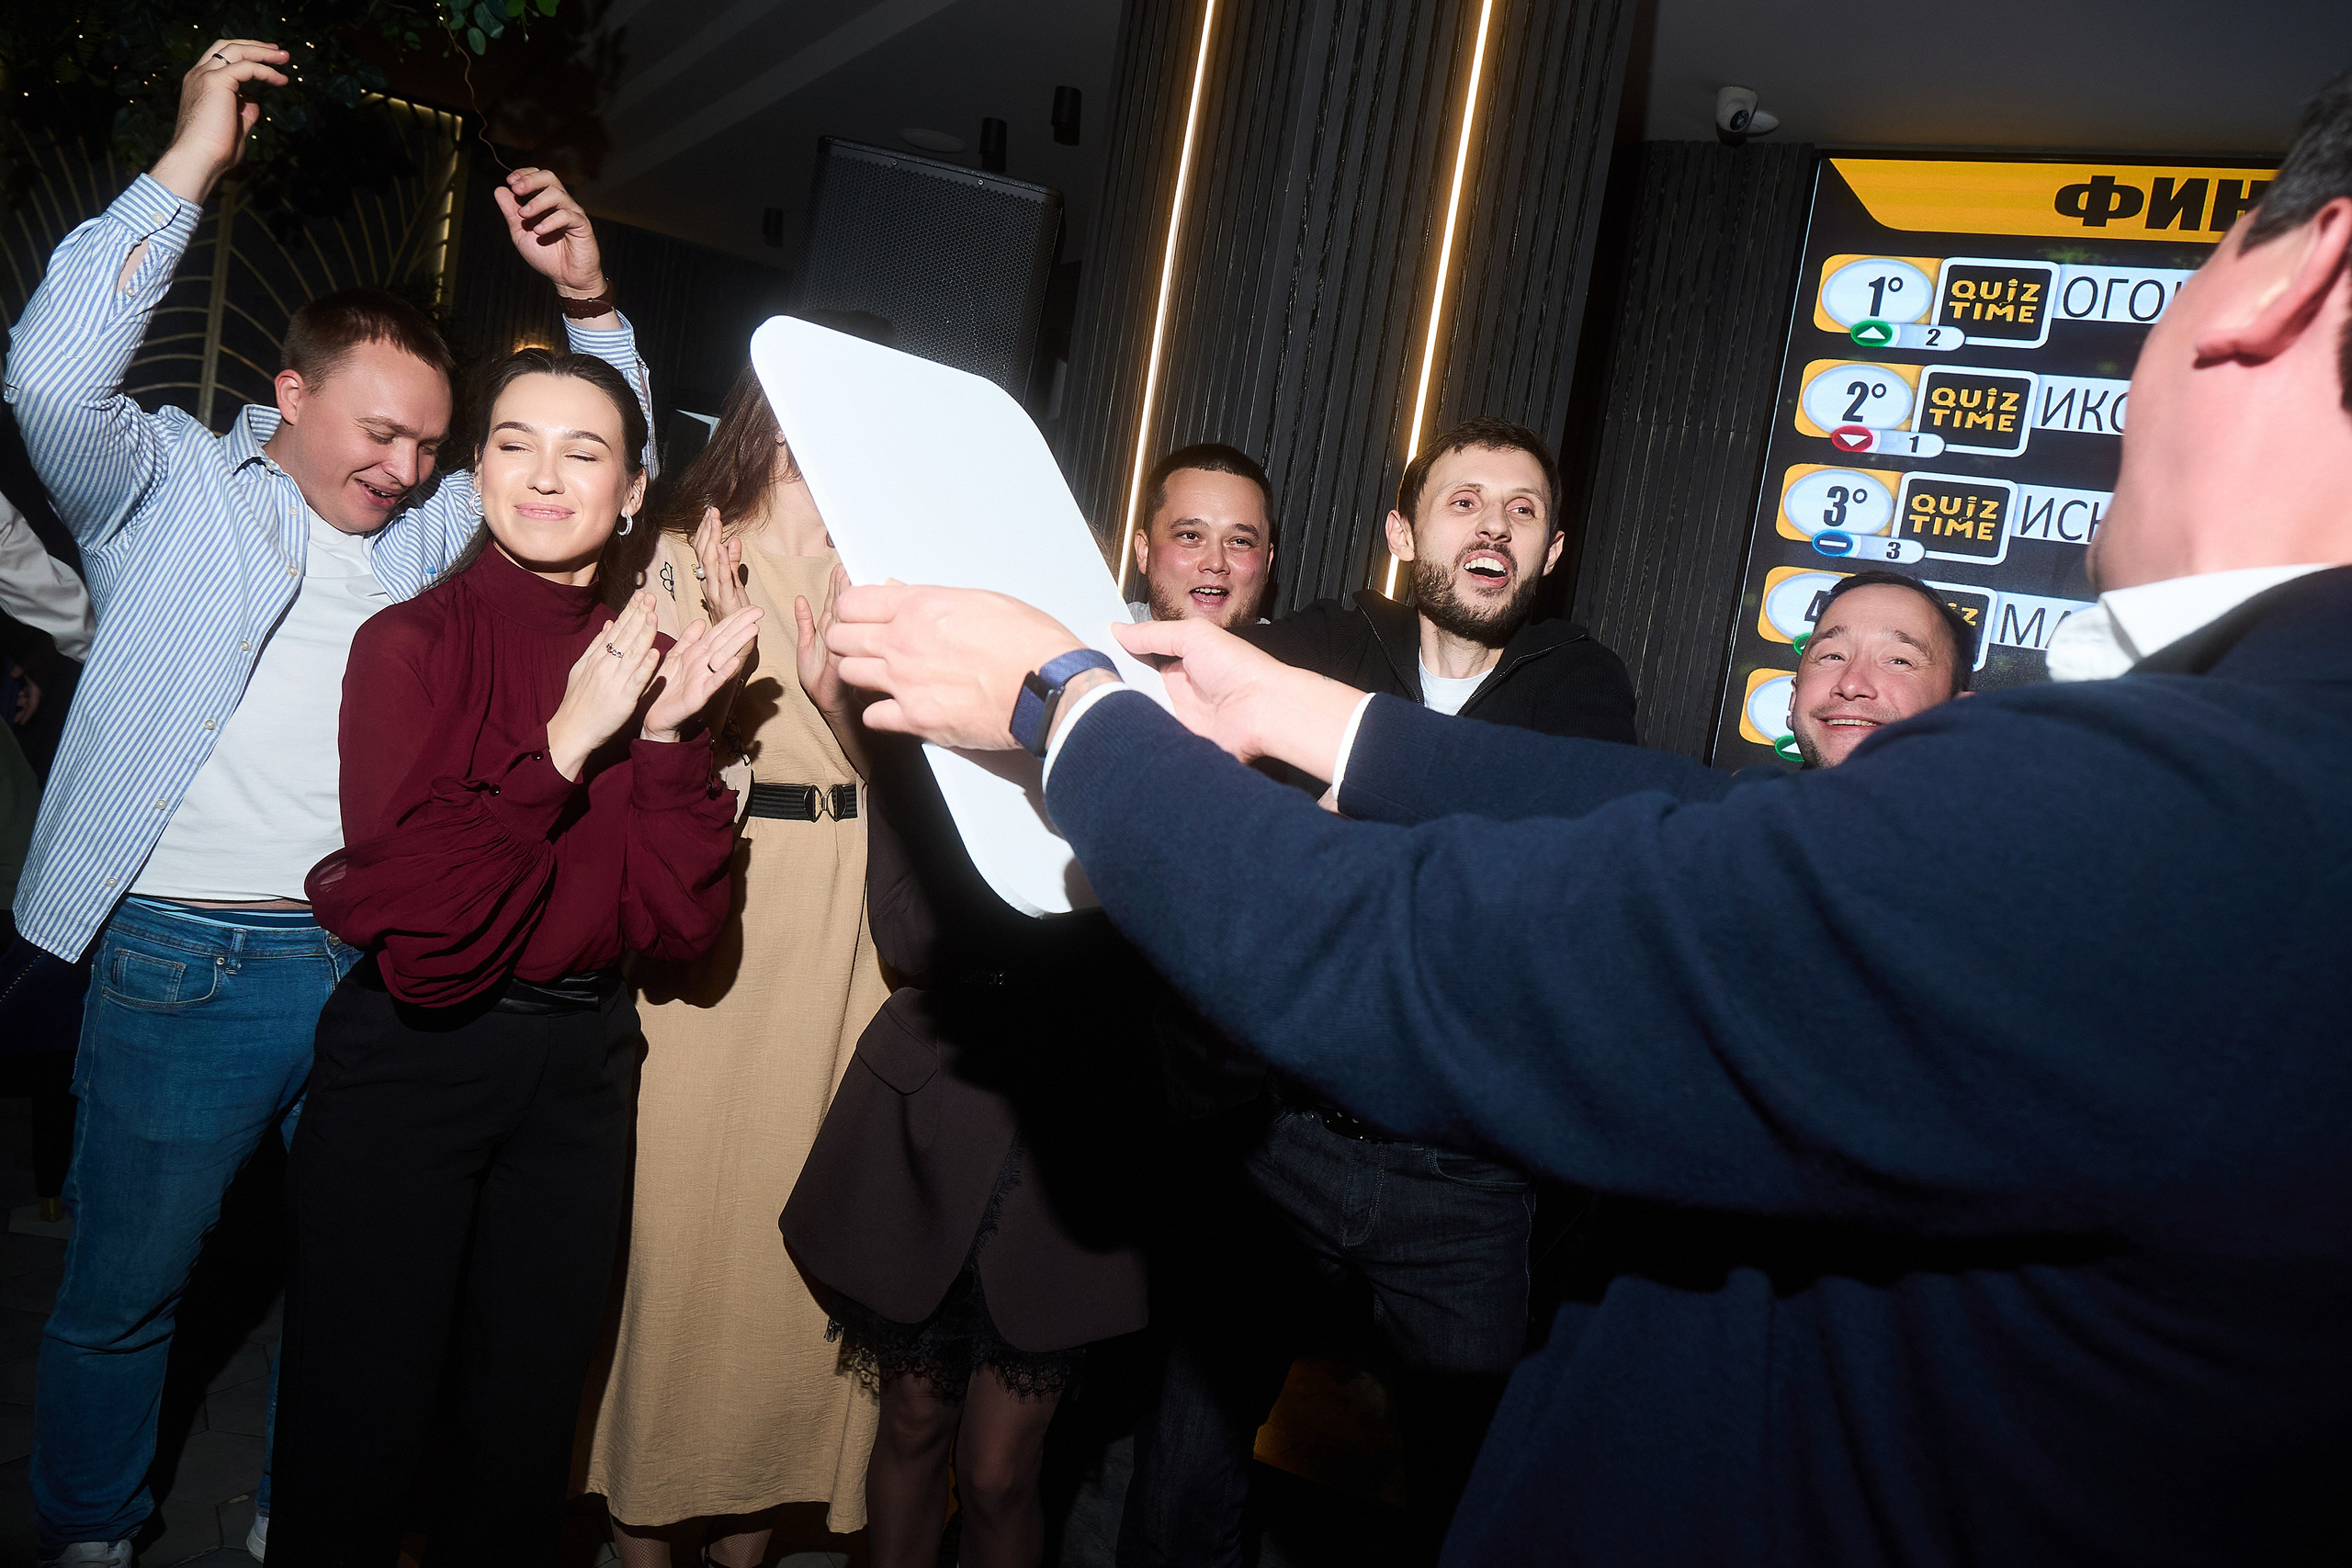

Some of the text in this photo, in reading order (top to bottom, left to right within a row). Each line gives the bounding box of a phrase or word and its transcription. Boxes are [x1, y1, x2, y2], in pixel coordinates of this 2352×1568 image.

[1949, 301, 2037, 323] TIME
[1925, 329, 1941, 346] 2
[1929, 409, 2017, 433] TIME
[1909, 435, 1920, 453] 1
[1908, 514, 1996, 541] TIME
[1886, 542, 1901, 559] 3
